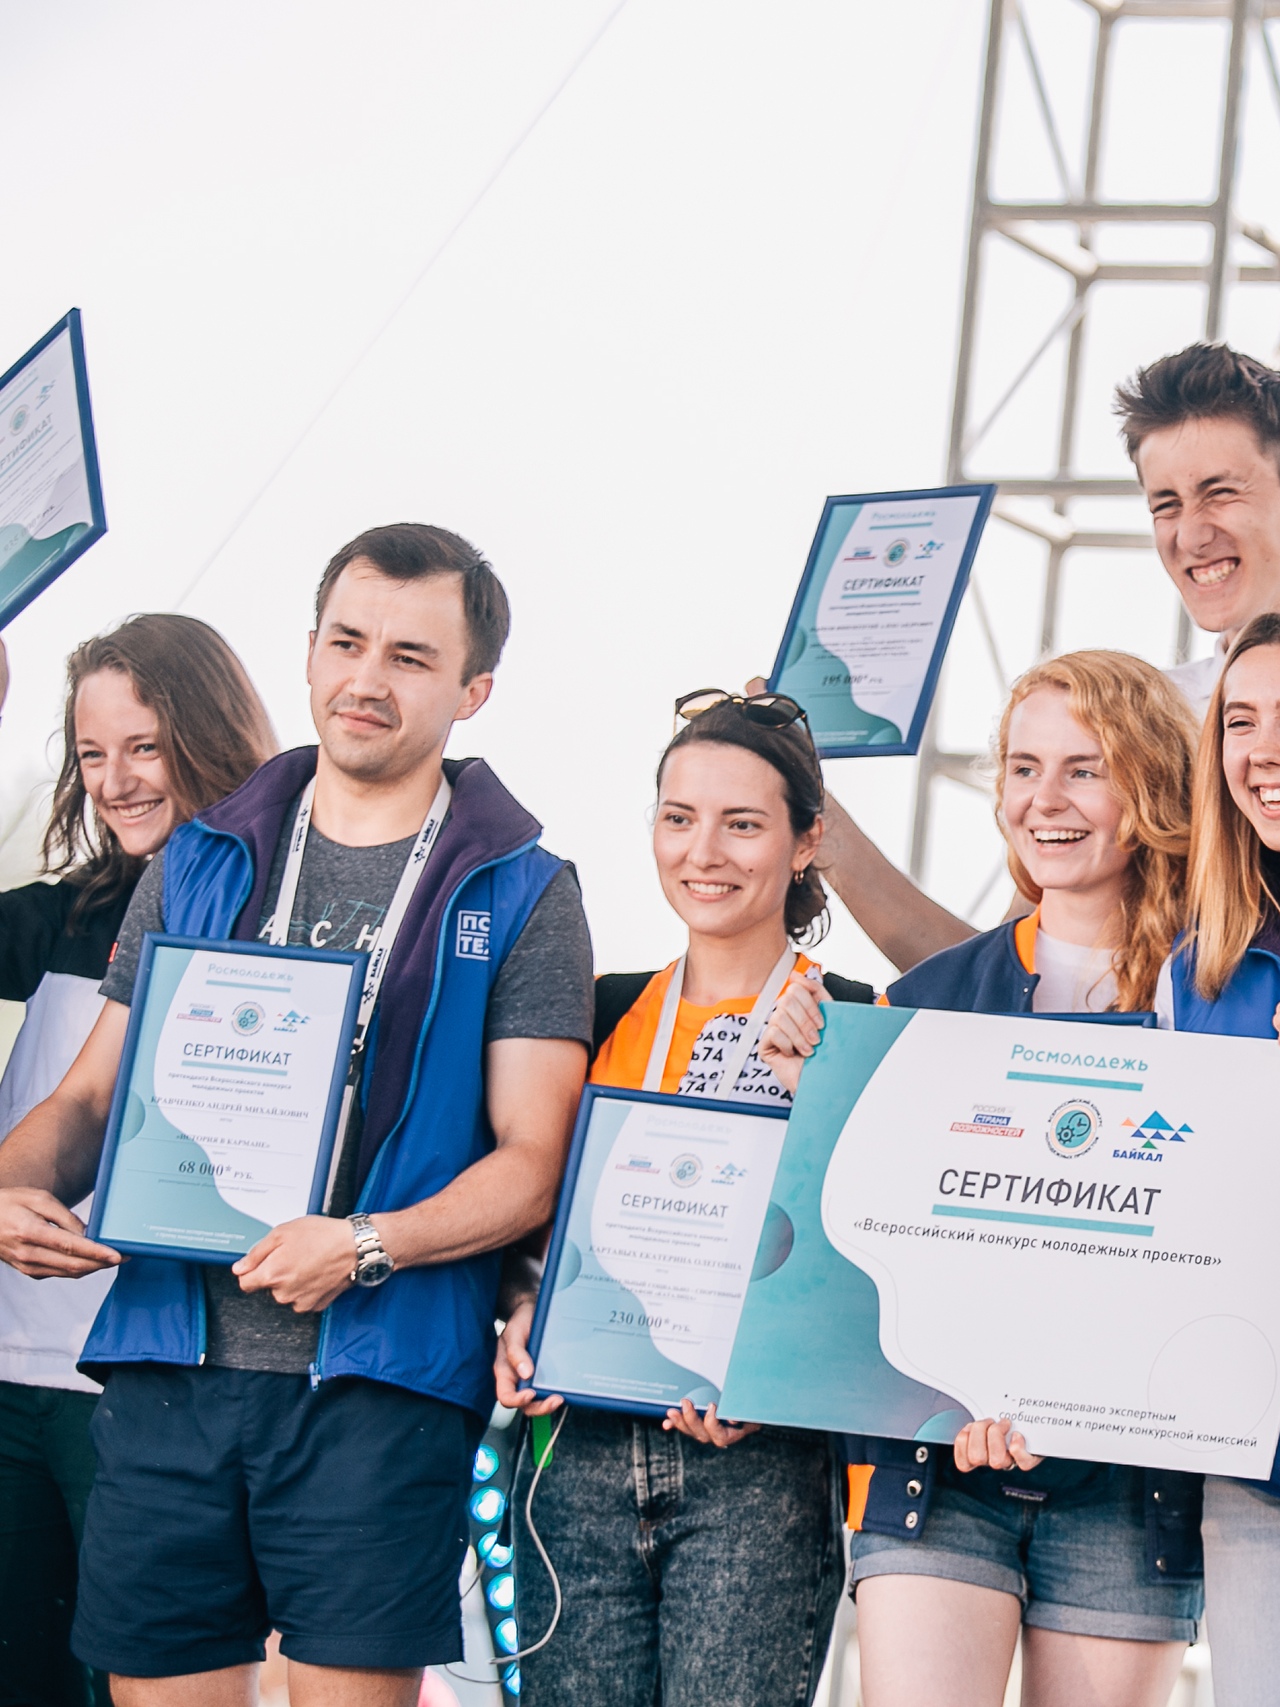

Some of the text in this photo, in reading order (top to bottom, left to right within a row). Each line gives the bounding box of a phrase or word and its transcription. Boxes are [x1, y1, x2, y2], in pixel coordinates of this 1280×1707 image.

[0, 413, 52, 469] РТИФИКАТ
[843, 575, 925, 591] СЕРТИФИКАТ
[207, 962, 294, 981] Росмолодежь
[183, 1042, 292, 1066] СЕРТИФИКАТ
[1010, 1043, 1149, 1072] Росмолодежь
[150, 1096, 309, 1119] КРАВЧЕНКО АНДРЕЙ МИХАЙЛОВИЧ
[952, 1122, 1023, 1138] ВОЗМОЖНОСТЕЙ
[975, 1115, 1008, 1126] СТРАНА
[176, 1133, 218, 1144] «ИСТОРИЯ
[1112, 1149, 1163, 1163] БАЙКАЛ
[178, 1160, 195, 1174] 68
[234, 1171, 254, 1180] РУБ.
[938, 1168, 1162, 1217] СЕРТИФИКАТ
[621, 1192, 729, 1218] СЕРТИФИКАТ
[853, 1218, 1222, 1268] «Всероссийский конкурс молодежных проектов»
[639, 1251, 692, 1265] ЕКАТЕРИНА
[693, 1258, 742, 1271] ОЛЕГОВНА
[609, 1310, 634, 1325] 230
[1018, 1396, 1176, 1423] рекомендовано экспертным
[999, 1411, 1258, 1448] сообществом к приему конкурсной комиссией
